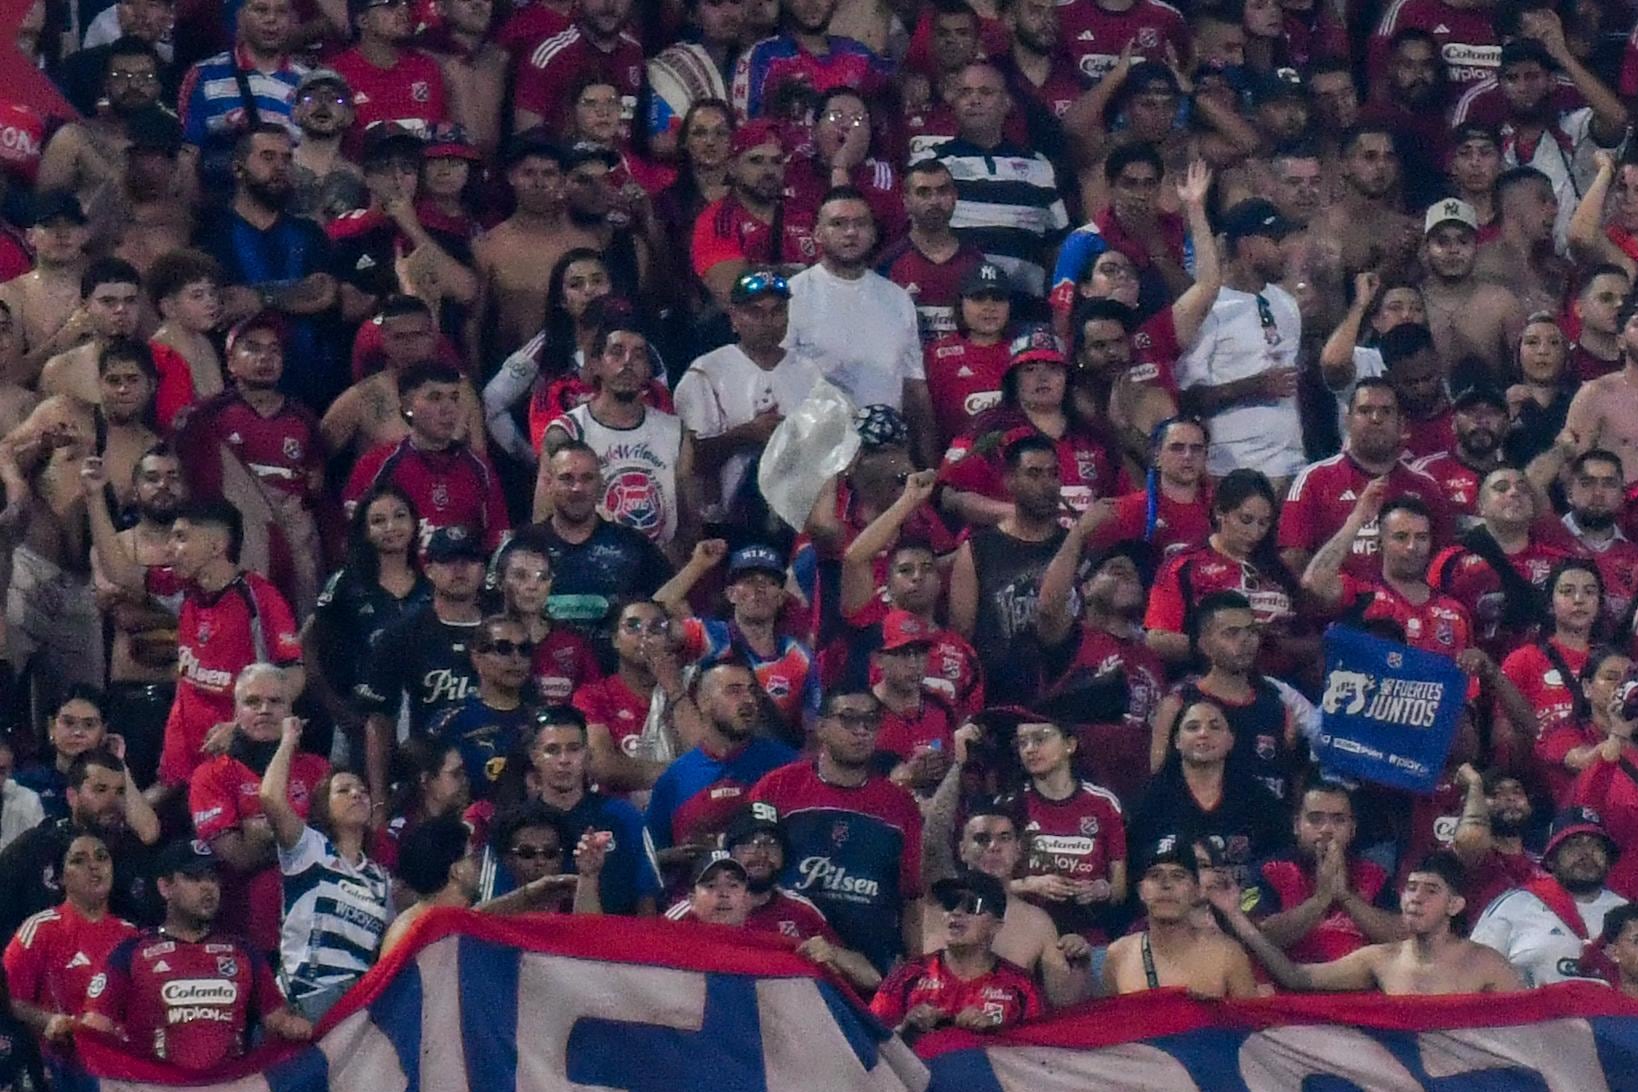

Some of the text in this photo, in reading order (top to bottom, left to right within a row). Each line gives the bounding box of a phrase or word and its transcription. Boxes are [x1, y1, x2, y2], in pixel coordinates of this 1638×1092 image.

[1444, 46, 1501, 61] Colant
[1393, 679, 1444, 701] FUERTES
[1364, 694, 1439, 727] JUNTOS
[795, 856, 880, 896] Pilsen
[163, 984, 236, 1000] Colanta
